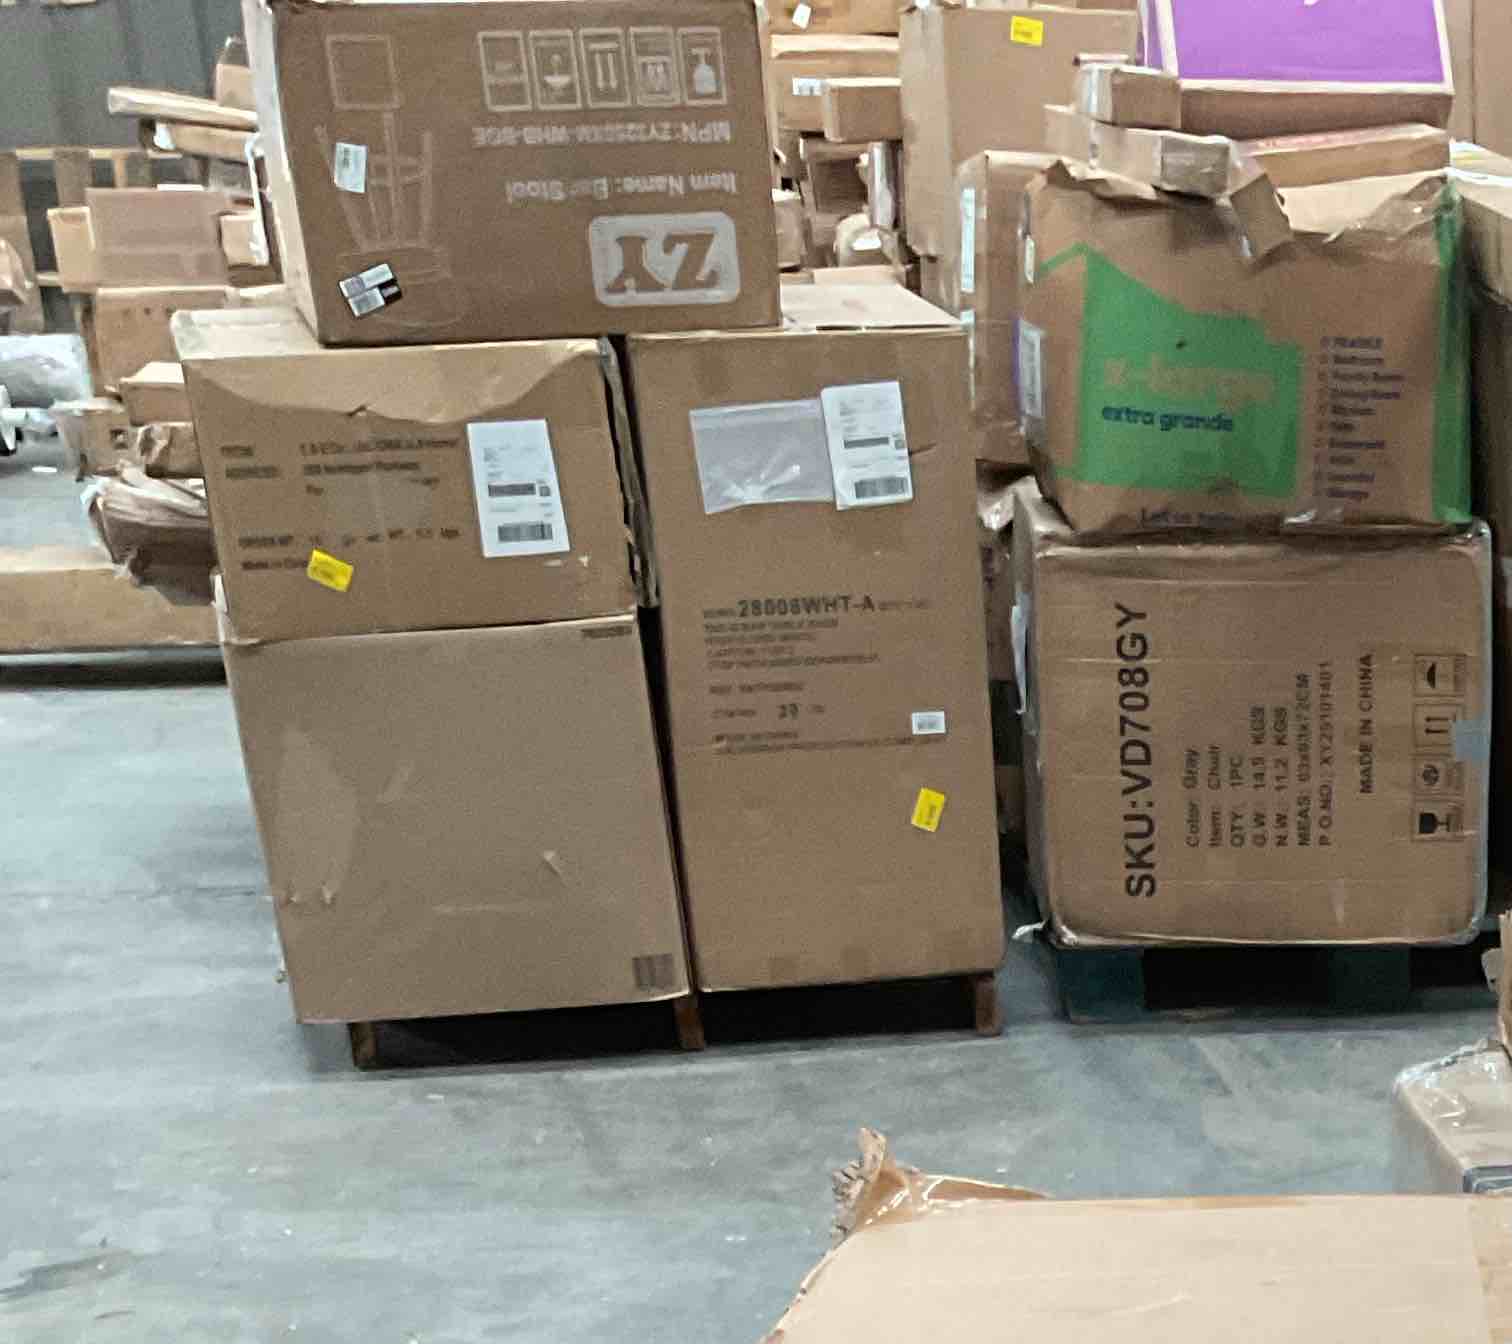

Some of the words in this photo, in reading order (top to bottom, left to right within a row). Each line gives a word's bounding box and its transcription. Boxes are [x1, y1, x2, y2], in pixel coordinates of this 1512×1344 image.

[613, 173, 685, 197] Name:
[690, 171, 738, 196] Item
[603, 232, 720, 296] ZY
[1102, 406, 1154, 425] extra
[1159, 412, 1234, 432] grande
[1358, 652, 1374, 713] CHINA
[1358, 719, 1374, 737] IN
[1114, 602, 1157, 898] SKU:VD708GY
[1358, 743, 1374, 794] MADE
